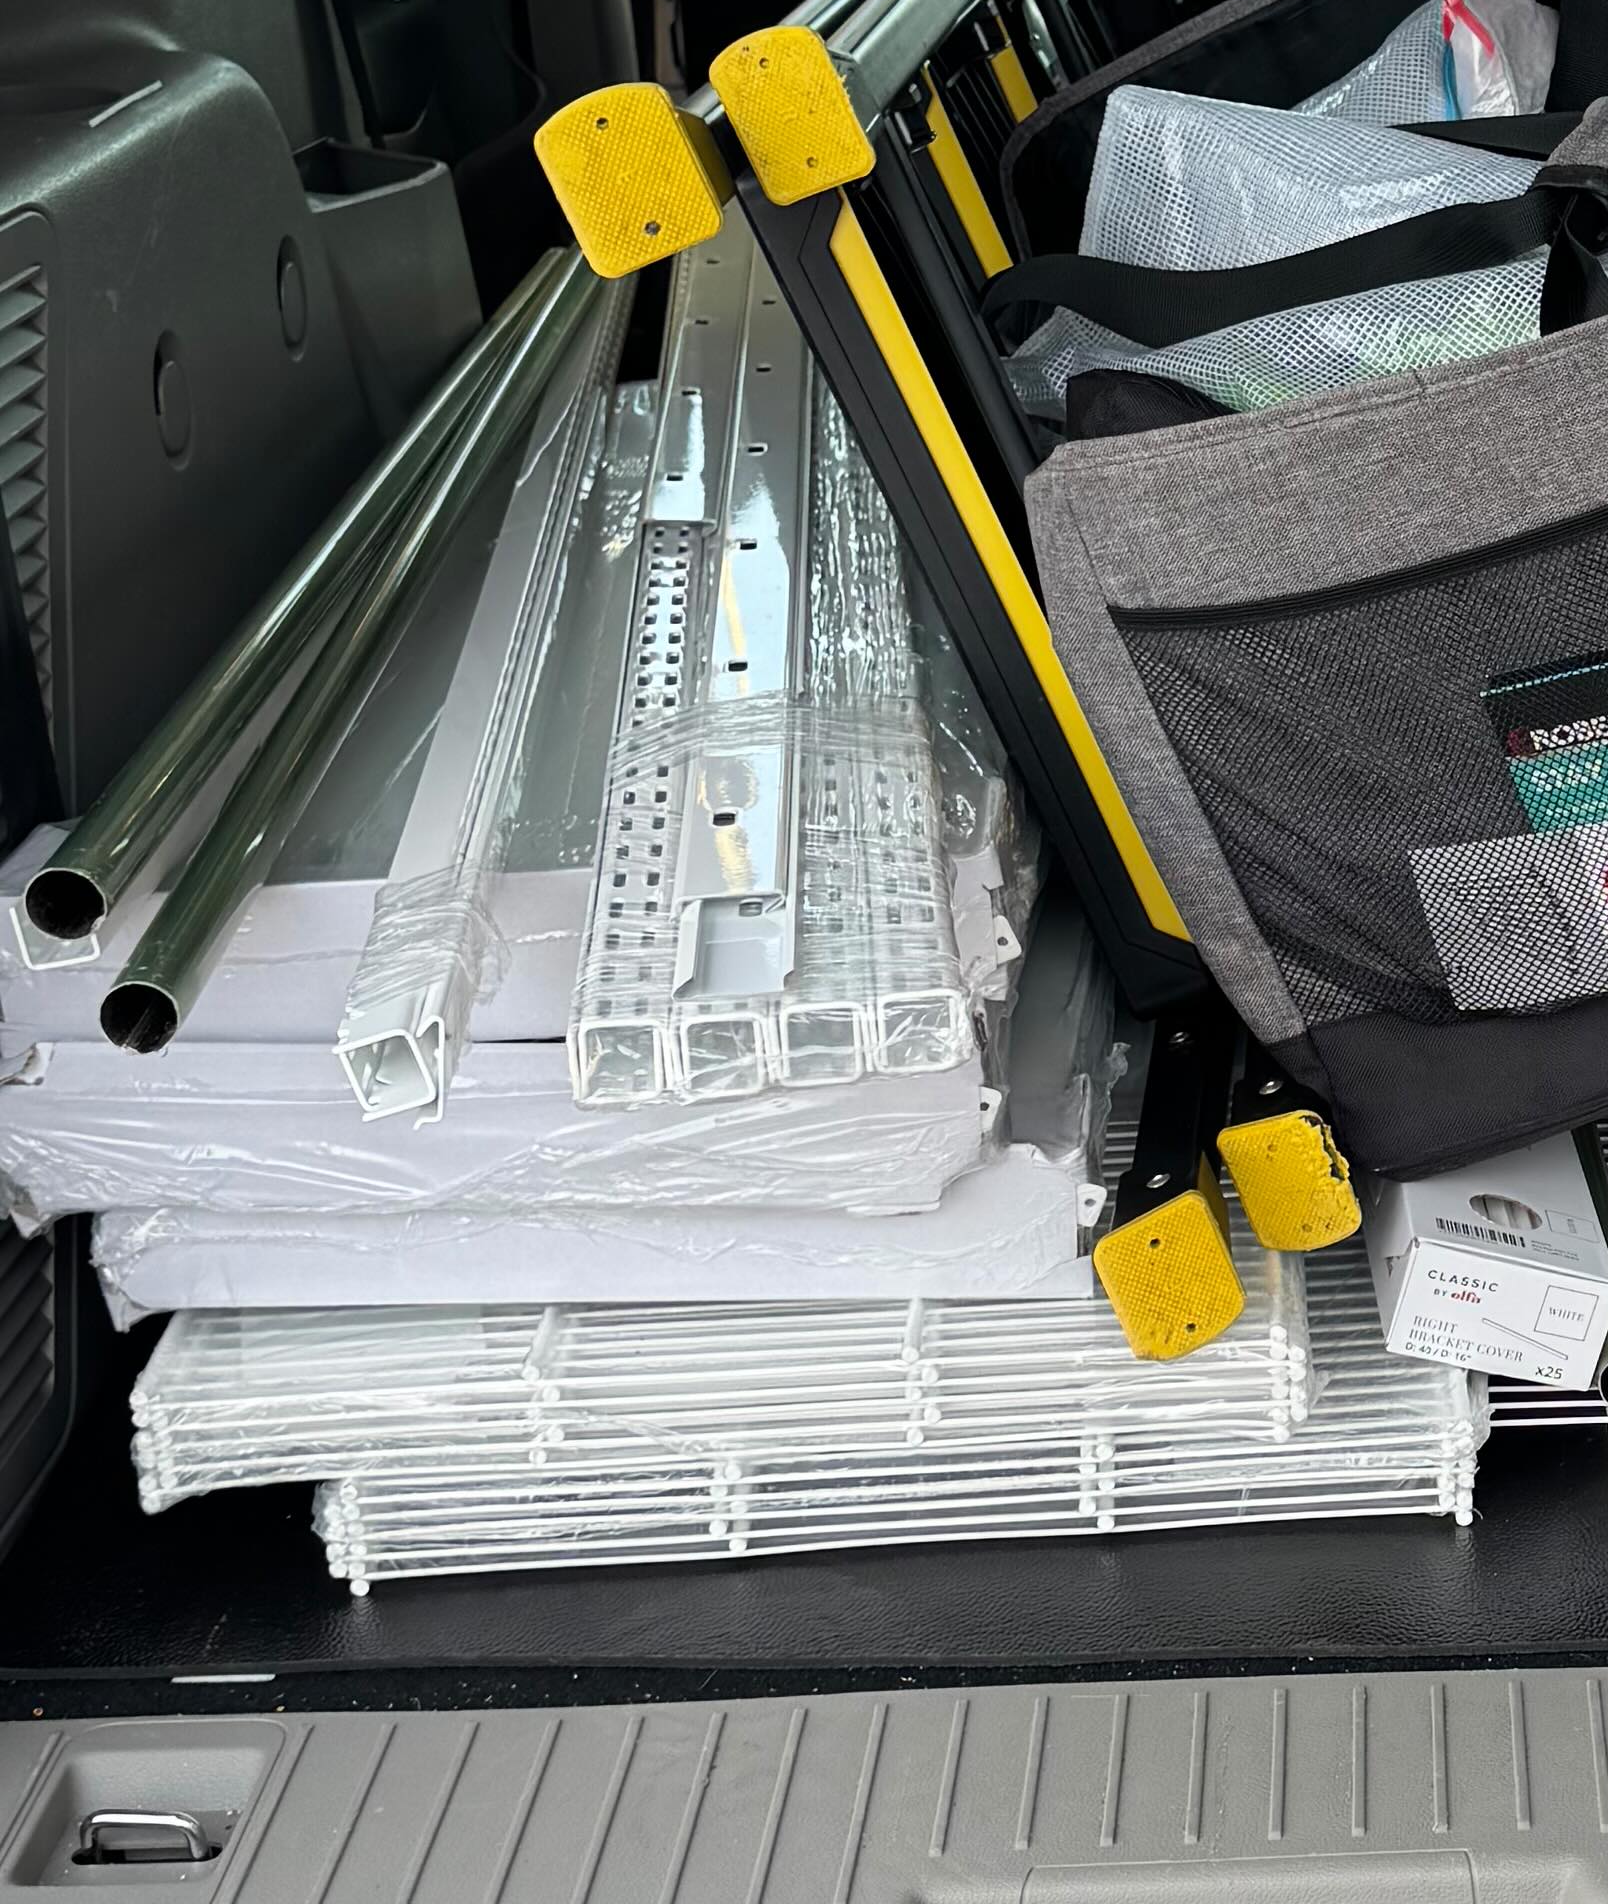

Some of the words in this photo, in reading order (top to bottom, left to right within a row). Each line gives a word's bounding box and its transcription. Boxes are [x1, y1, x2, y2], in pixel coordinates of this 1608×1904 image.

[1531, 757, 1604, 795] STAY
[1428, 1270, 1499, 1293] CLASSIC
[1433, 1287, 1448, 1297] BY
[1450, 1290, 1481, 1305] elfa
[1549, 1306, 1584, 1322] WHITE
[1413, 1316, 1459, 1334] RIGHT
[1409, 1330, 1475, 1353] BRACKET
[1476, 1343, 1526, 1362] COVER
[1535, 1366, 1564, 1380] x25
